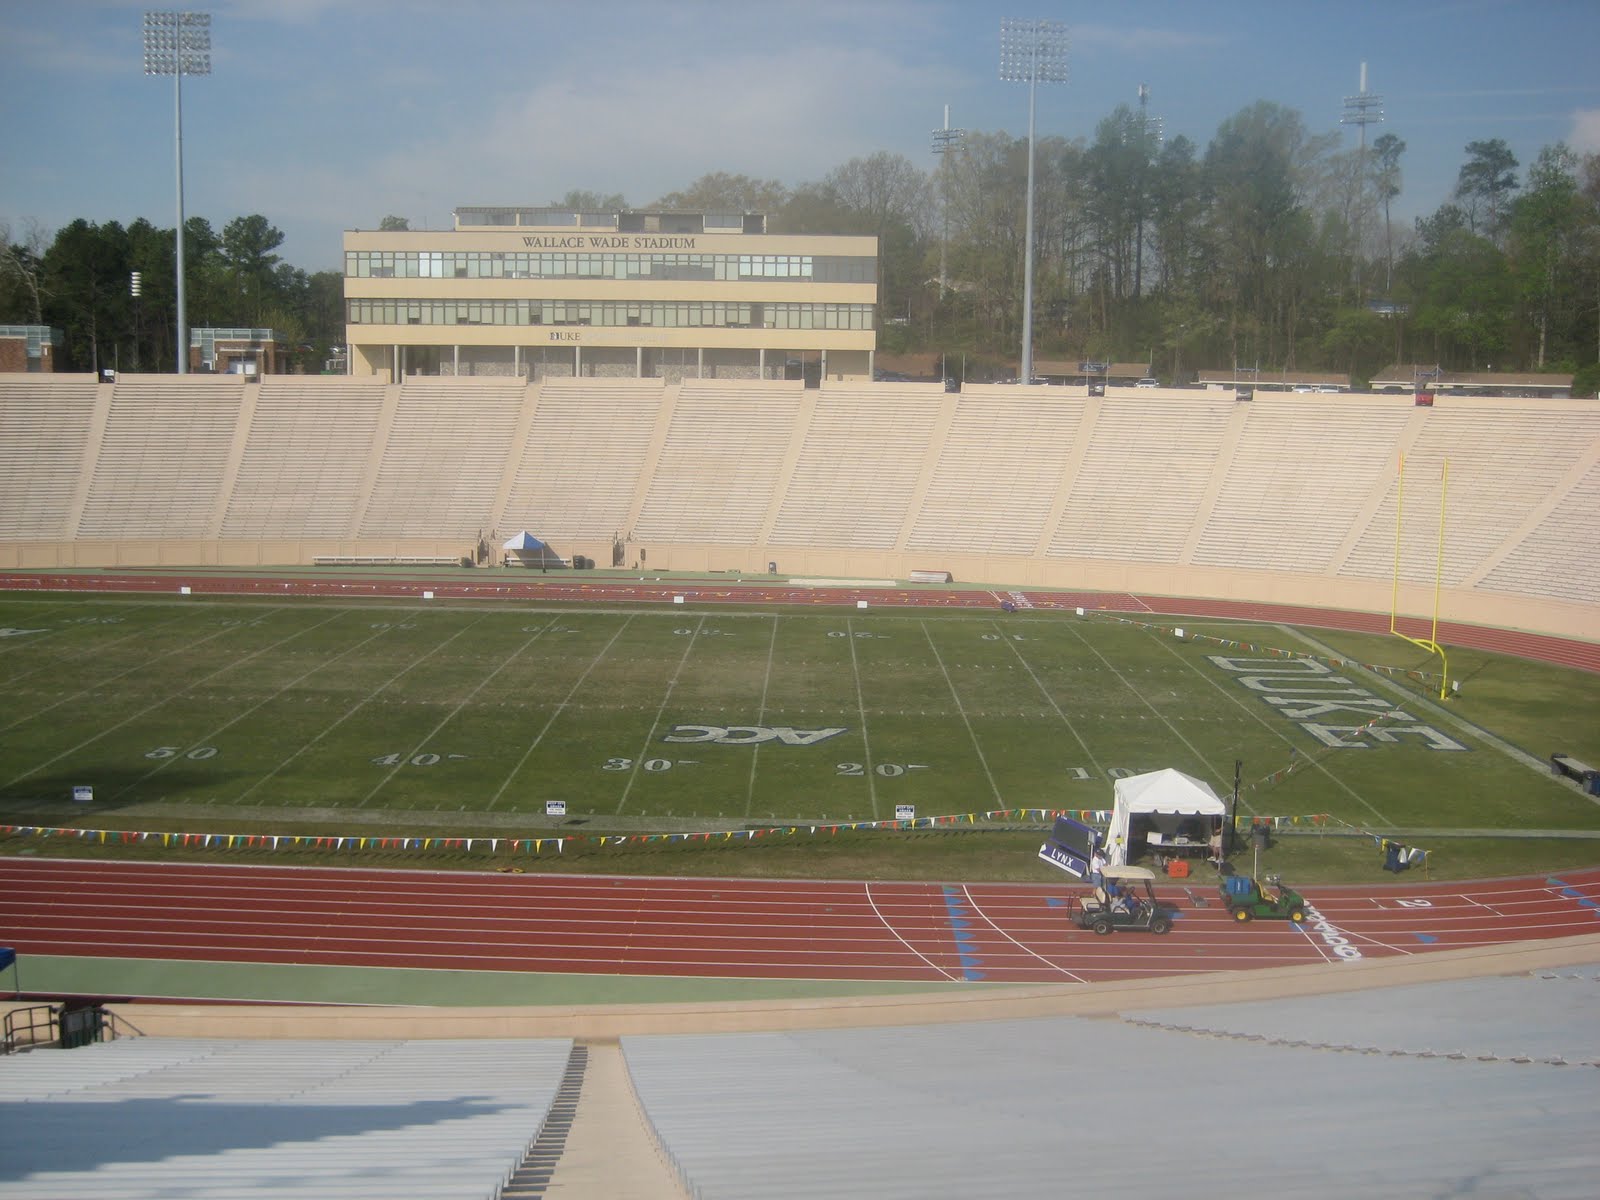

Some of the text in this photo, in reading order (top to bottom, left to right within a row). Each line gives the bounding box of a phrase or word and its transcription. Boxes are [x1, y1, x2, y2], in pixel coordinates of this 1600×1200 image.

[523, 237, 696, 249] WALLACE WADE STADIUM
[1206, 655, 1469, 751] DUKE
[664, 725, 848, 745] ACC
[145, 747, 219, 760] 50
[371, 753, 441, 766] 40
[602, 758, 672, 772] 30
[836, 763, 905, 777] 20
[1065, 767, 1137, 779] 10
[1051, 848, 1074, 867] LYNX
